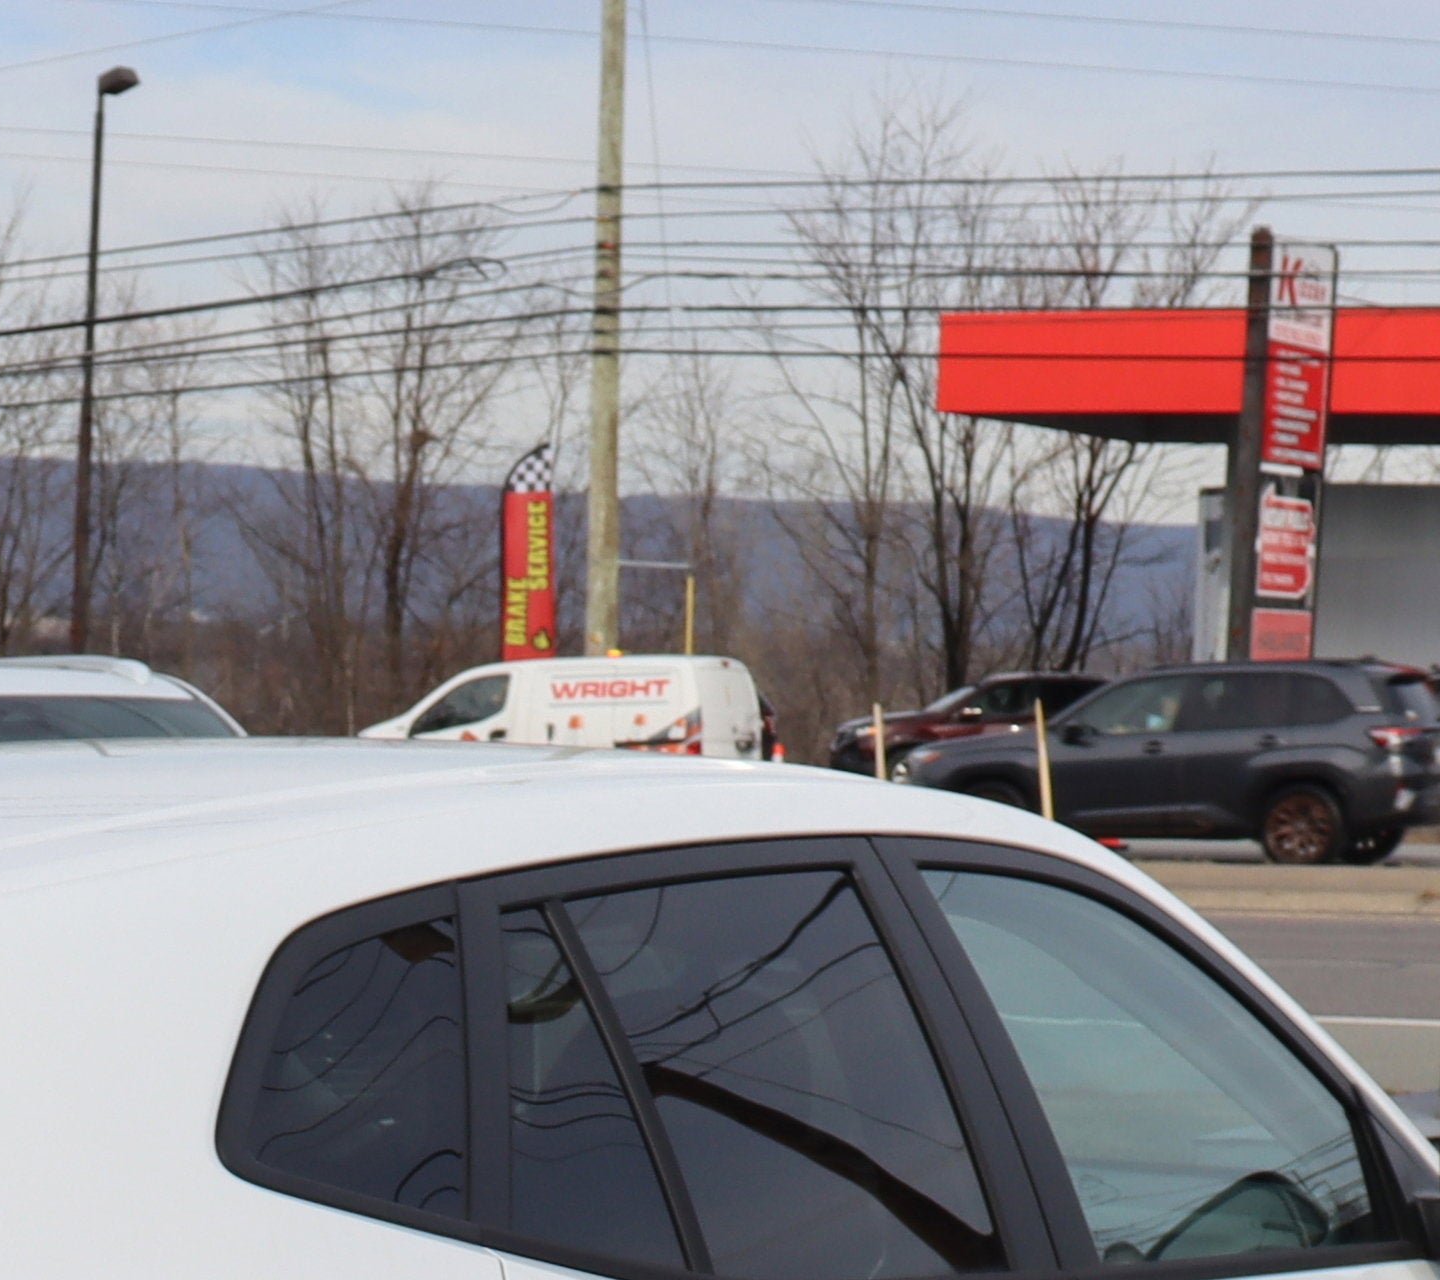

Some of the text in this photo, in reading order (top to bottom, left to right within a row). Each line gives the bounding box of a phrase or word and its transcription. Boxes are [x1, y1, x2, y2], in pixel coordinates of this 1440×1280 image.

[527, 500, 548, 590] SERVICE
[505, 577, 526, 646] BRAKE
[550, 678, 671, 700] WRIGHT
